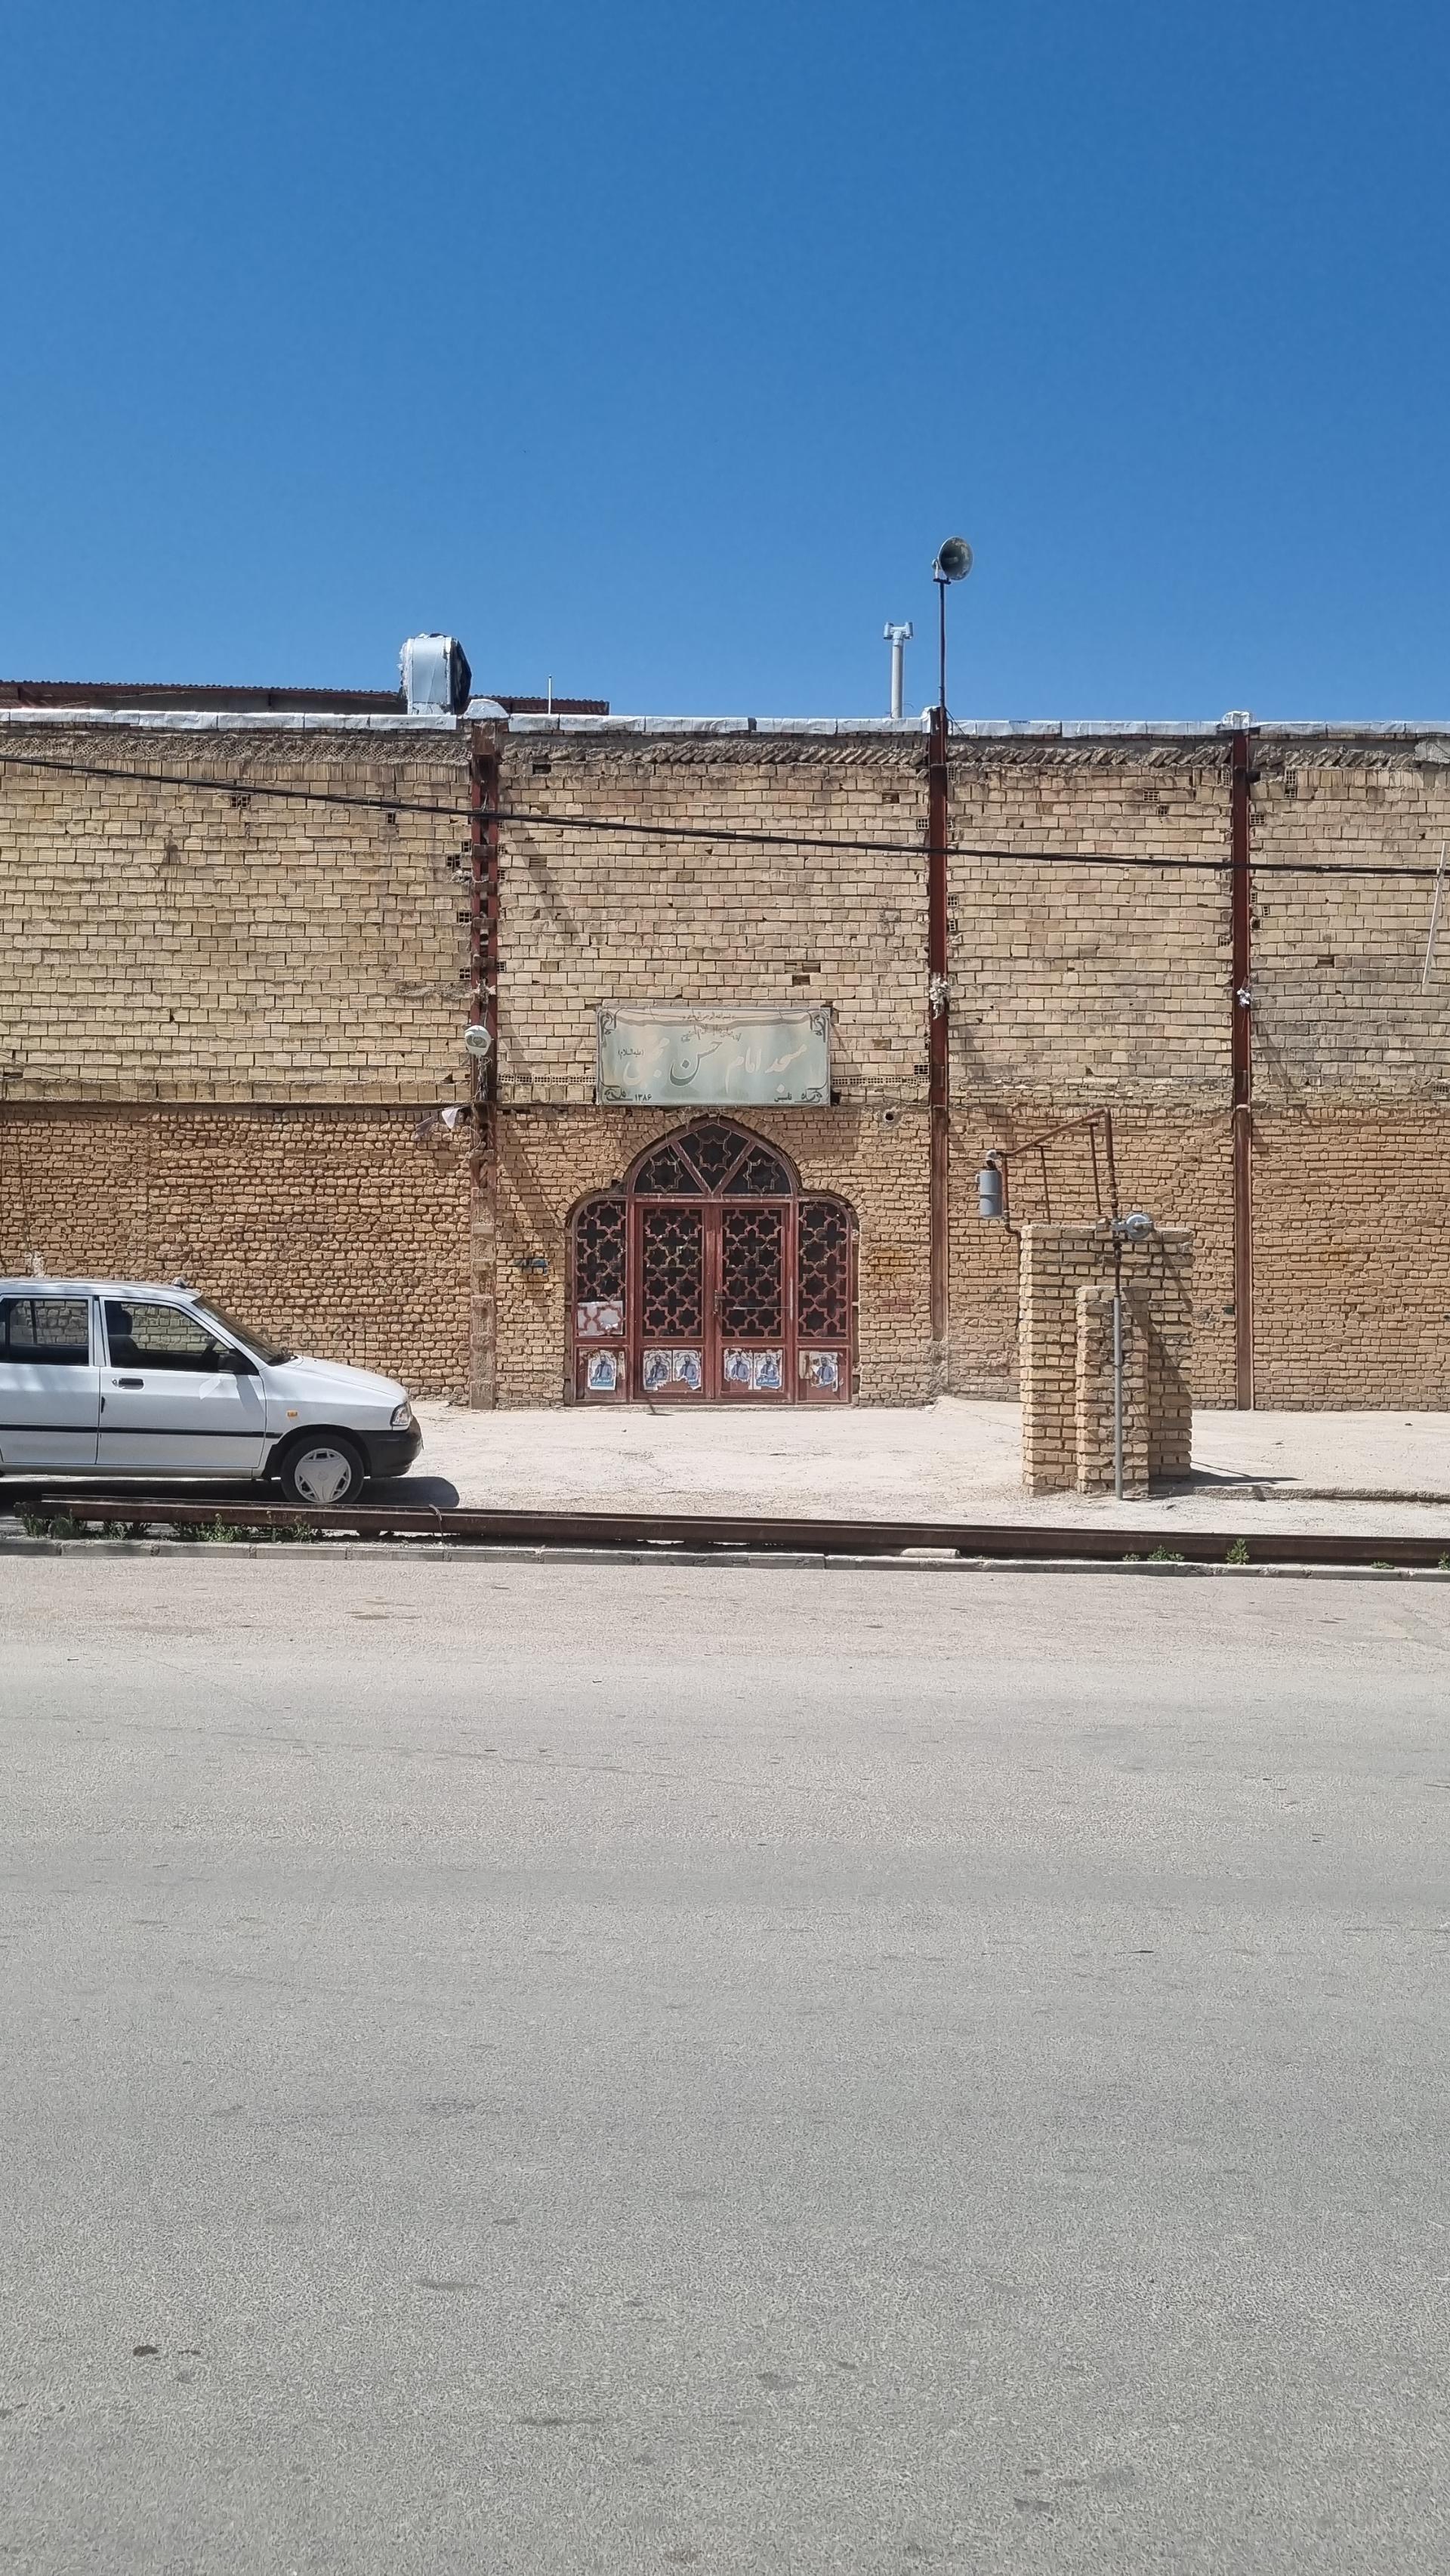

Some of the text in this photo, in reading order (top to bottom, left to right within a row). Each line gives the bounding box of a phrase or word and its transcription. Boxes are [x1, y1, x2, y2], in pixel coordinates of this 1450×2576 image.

[622, 1036, 807, 1095] مسجد امام حسن مجی
[634, 1092, 652, 1102] ۱۳۸۶
